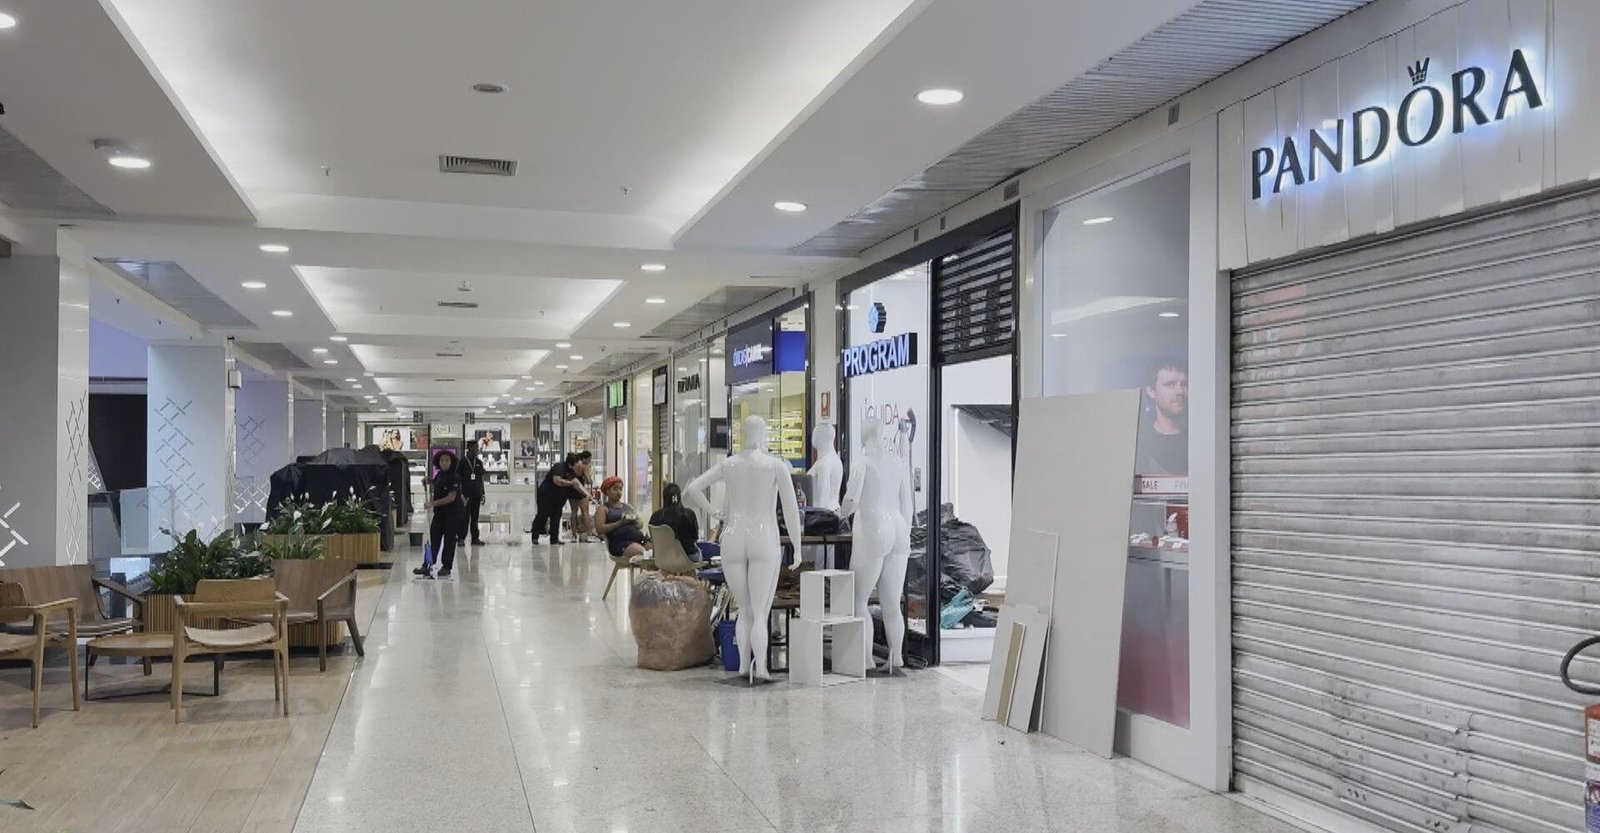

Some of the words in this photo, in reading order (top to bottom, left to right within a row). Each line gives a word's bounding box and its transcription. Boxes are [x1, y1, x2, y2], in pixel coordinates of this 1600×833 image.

[1252, 48, 1543, 200] PANDORA
[843, 333, 911, 377] PROGRAM
[1142, 479, 1159, 490] SALE
